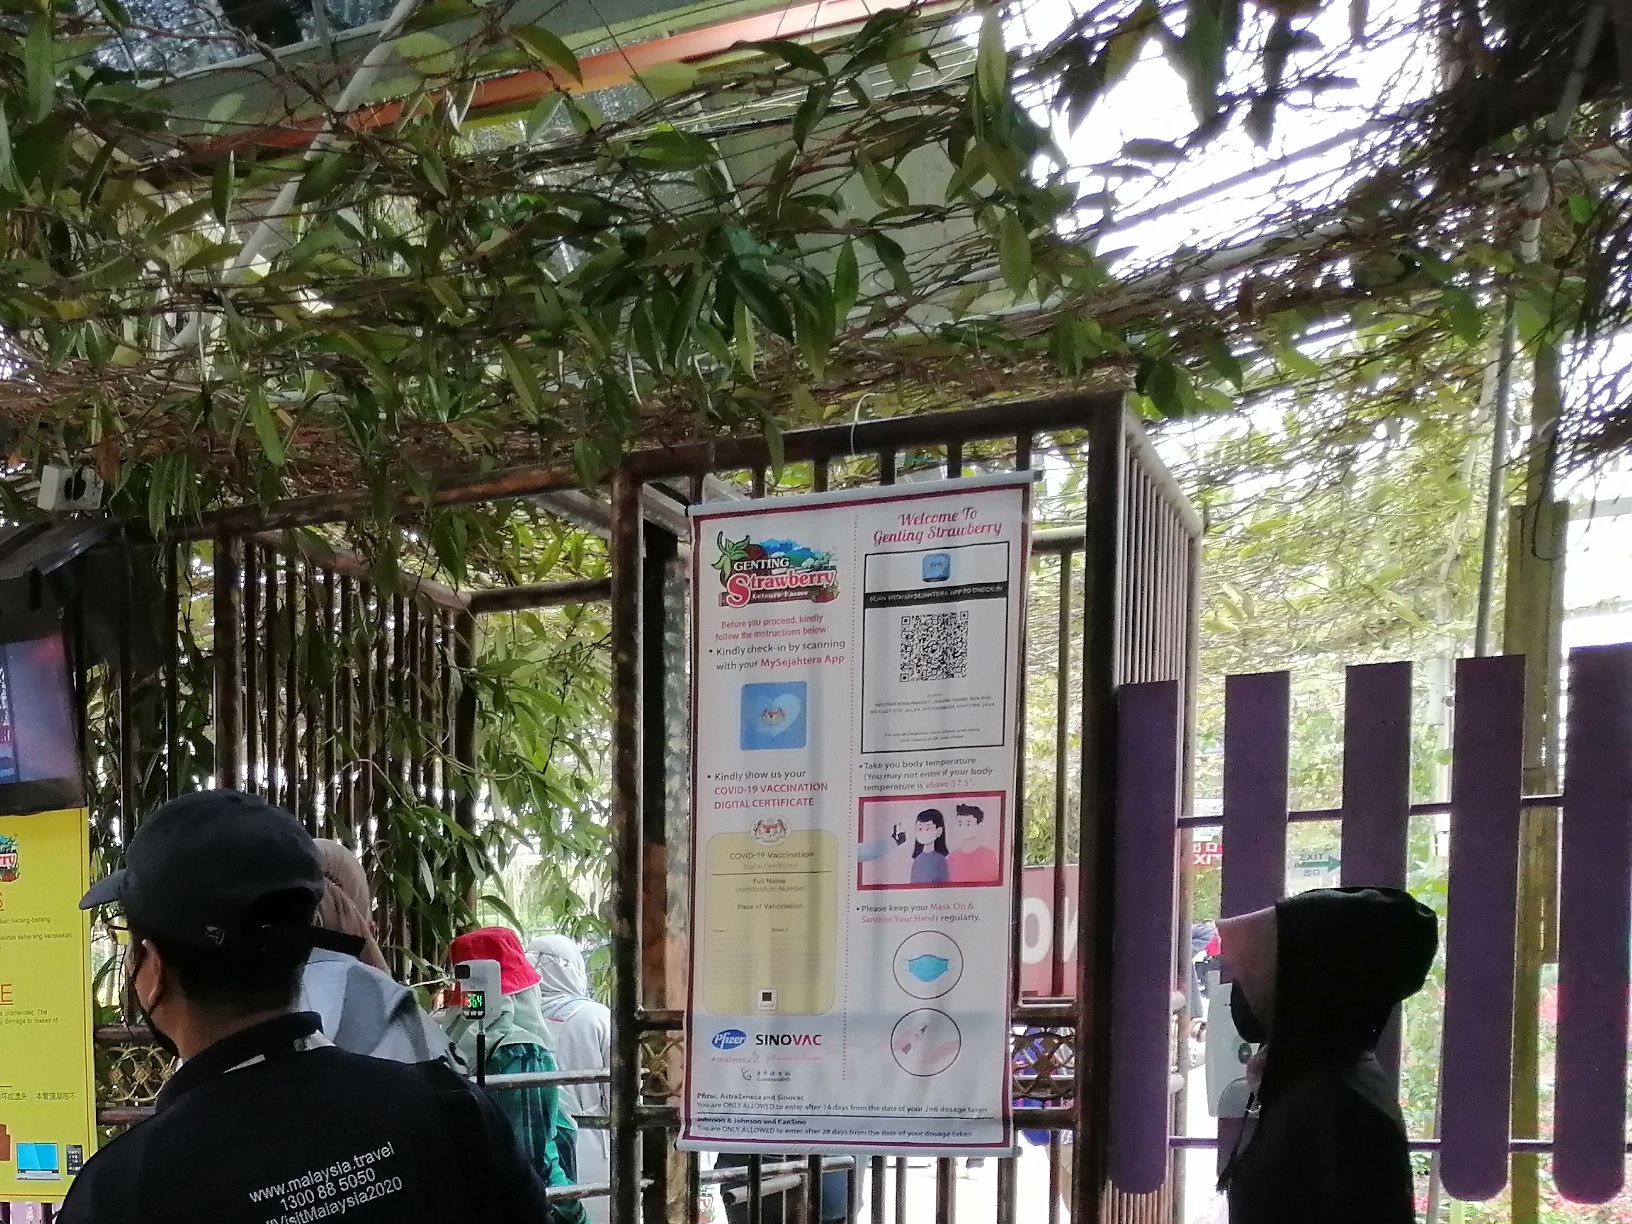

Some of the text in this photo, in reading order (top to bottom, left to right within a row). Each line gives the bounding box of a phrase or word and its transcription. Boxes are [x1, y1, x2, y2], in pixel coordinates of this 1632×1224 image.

[898, 506, 979, 526] Welcome To
[873, 522, 1002, 547] Genting Strawberry
[734, 558, 790, 571] GENTING
[727, 569, 837, 608] Strawberry
[721, 614, 824, 629] Before you proceed, kindly
[715, 626, 829, 641] follow the instructions below:
[716, 639, 846, 656] Kindly check-in by scanning
[716, 654, 845, 671] with your MySejahtera App
[864, 758, 977, 771] Take you body temperature
[714, 770, 807, 781] Kindly show us your
[884, 772, 902, 780] may
[903, 771, 918, 779] not
[919, 770, 941, 778] enter
[942, 768, 949, 776] if
[949, 769, 969, 779] your
[970, 766, 993, 776] body
[714, 782, 828, 795] COVID-19 VACCINATION
[863, 783, 915, 792] temperature
[925, 781, 949, 789] above
[714, 797, 814, 810] DIGITAL CERTIFICATE
[729, 851, 814, 860] COVID-19 Vaccination
[1299, 853, 1324, 861] EXIT
[861, 902, 974, 913] Please keep your Mask On &
[894, 915, 913, 923] Your
[914, 914, 939, 922] Hands
[940, 914, 981, 923] regularly.
[4, 1018, 26, 1026] damage
[714, 1031, 822, 1049] Pfizer SINOVAC
[743, 1102, 775, 1110] ALLOWED
[833, 1104, 849, 1112] days
[939, 1106, 967, 1114] dosage
[741, 1126, 775, 1134] ALLOWED
[831, 1128, 848, 1136] days
[248, 1141, 396, 1203] www.malaysia.travel
[280, 1167, 376, 1211] 1300 88 5050
